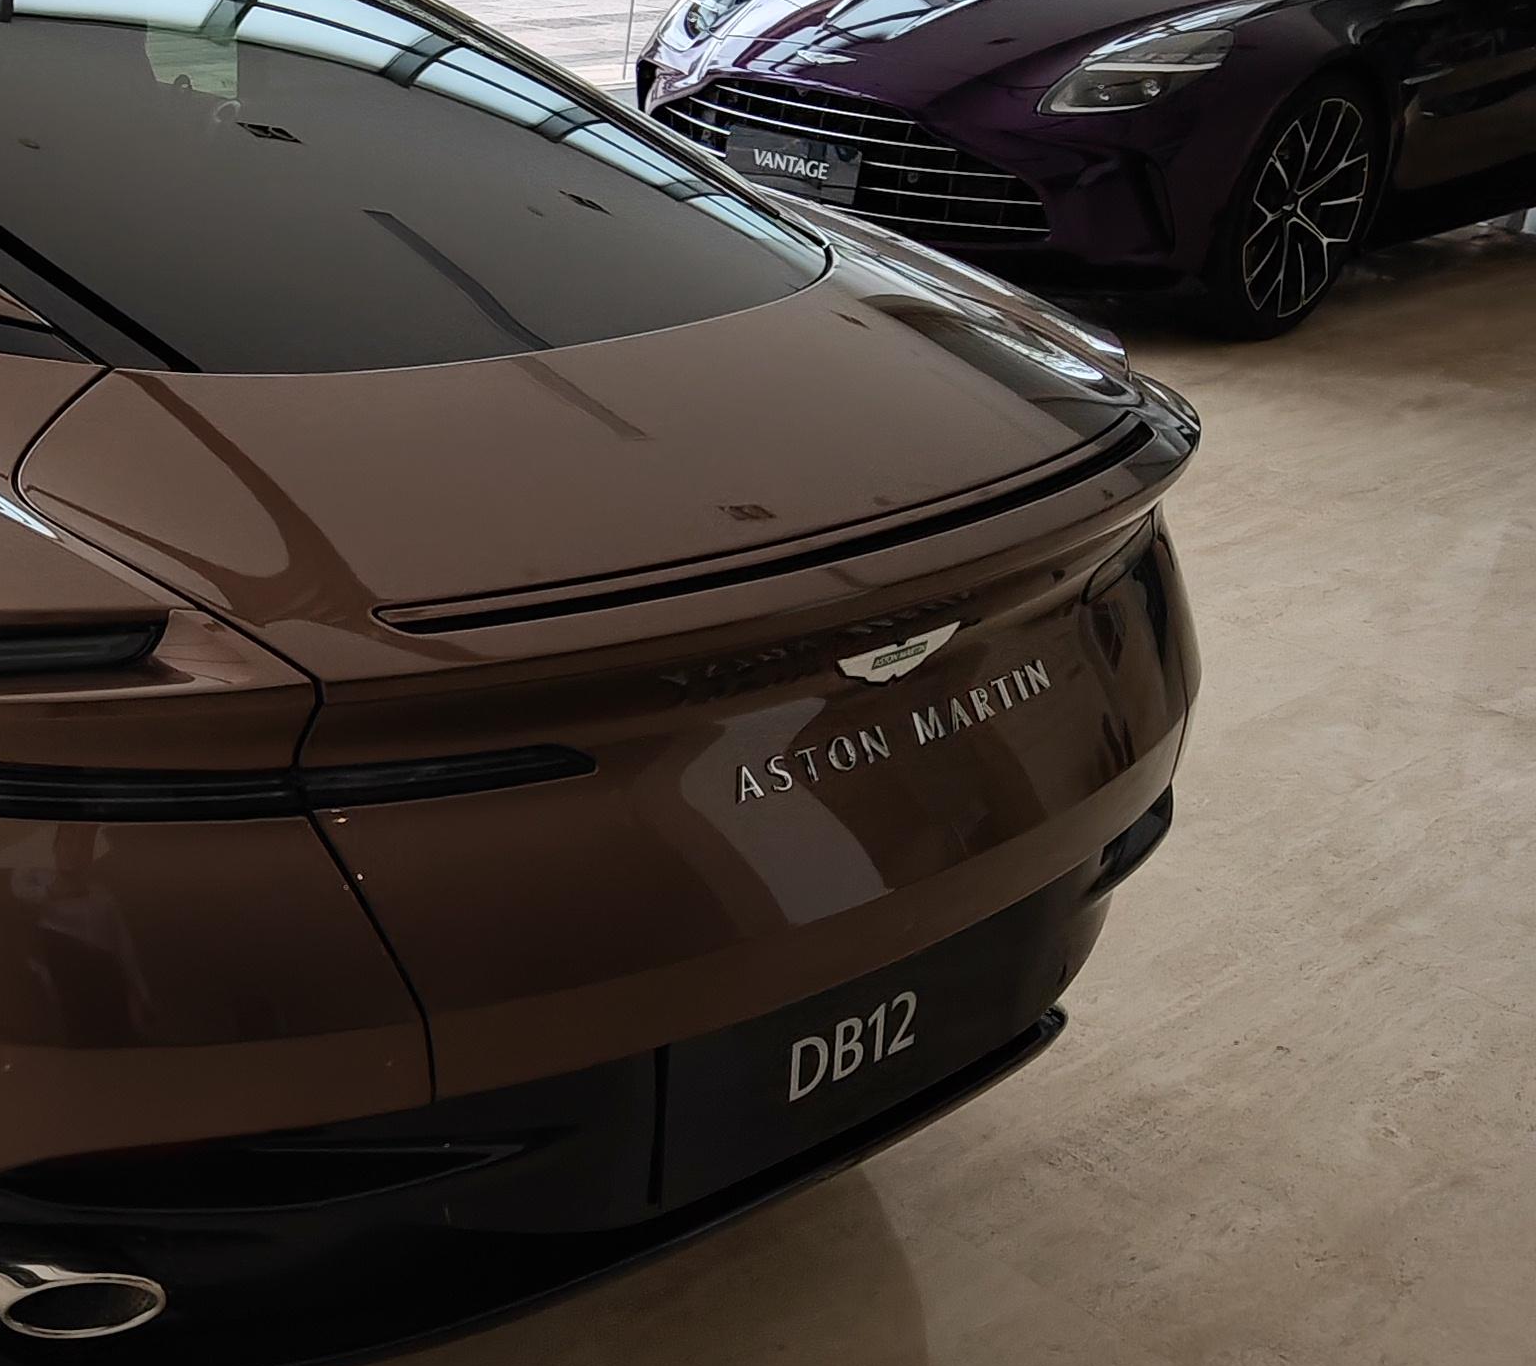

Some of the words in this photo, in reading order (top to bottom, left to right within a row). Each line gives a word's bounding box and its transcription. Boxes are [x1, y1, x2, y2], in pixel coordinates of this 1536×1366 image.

[753, 148, 830, 180] VANTAGE
[735, 724, 892, 804] ASTON
[911, 658, 1052, 745] MARTIN
[789, 991, 918, 1103] DB12
